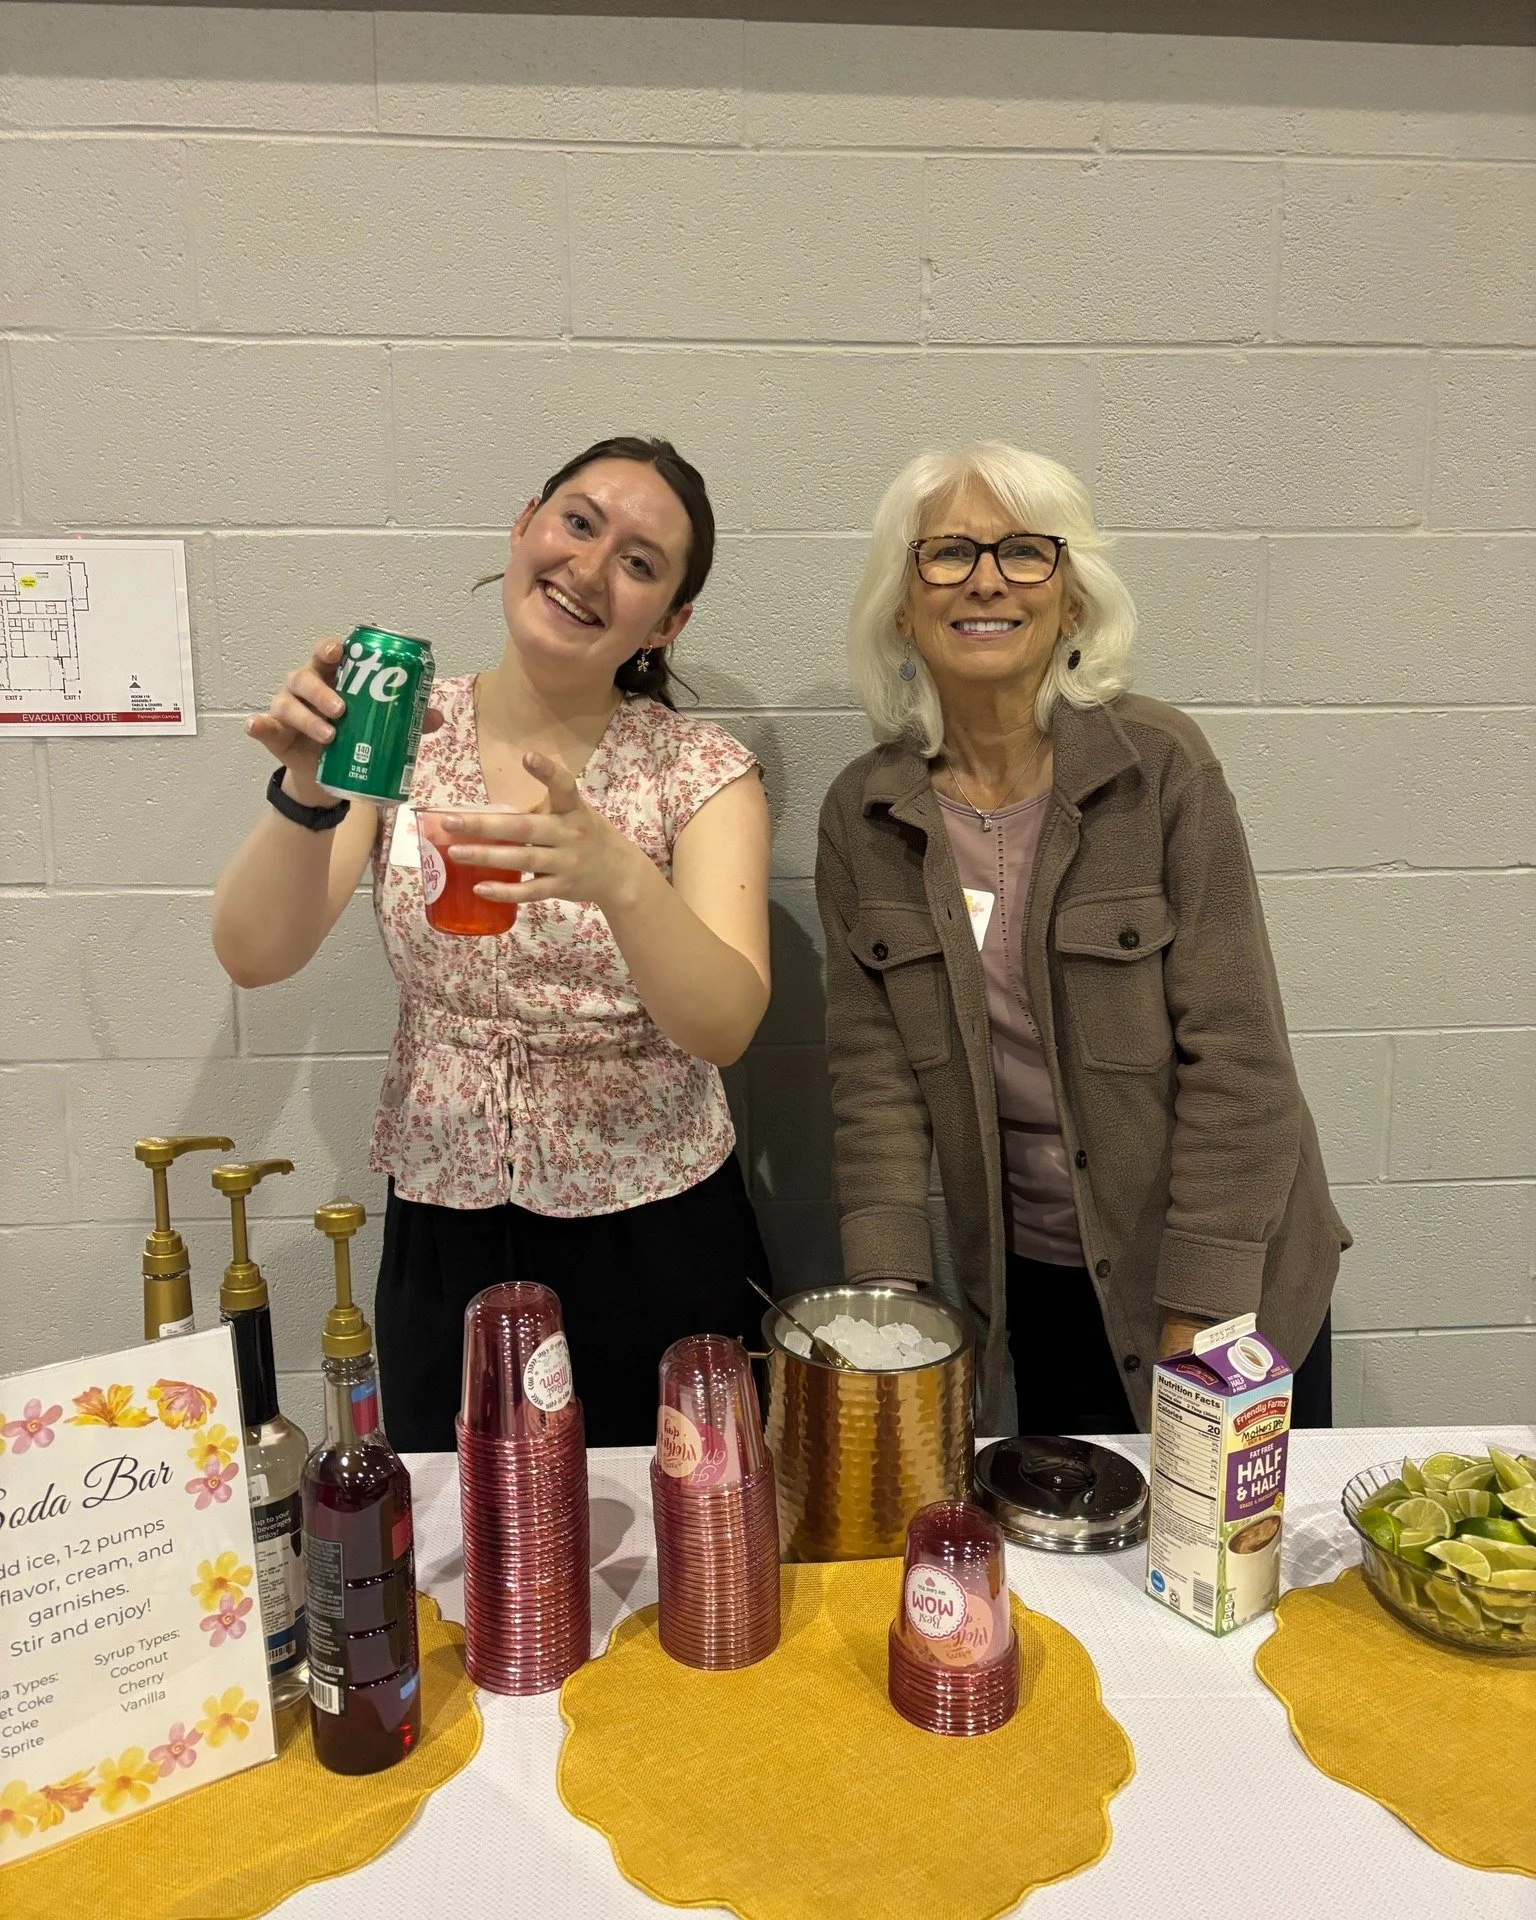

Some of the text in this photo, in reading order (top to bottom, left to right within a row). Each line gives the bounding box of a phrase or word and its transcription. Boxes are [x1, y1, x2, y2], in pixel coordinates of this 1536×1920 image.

[22, 713, 118, 722] EVACUATION ROUTE
[357, 744, 370, 754] 140
[1158, 1374, 1193, 1398] Nutrition
[1194, 1392, 1220, 1409] Facts
[1230, 1377, 1244, 1388] HALF
[1158, 1402, 1183, 1421] Calories
[1207, 1424, 1221, 1436] 20
[1236, 1404, 1267, 1426] Friendly
[1268, 1400, 1287, 1409] Farms
[1250, 1443, 1274, 1459] FAT FREE
[1238, 1447, 1282, 1484] HALF
[82, 1454, 173, 1508] Bar
[1236, 1469, 1281, 1502] & HALF
[256, 1517, 292, 1533] beverages
[27, 1553, 60, 1571] ice,
[64, 1539, 92, 1558] 1-2
[97, 1519, 165, 1552] pumps
[0, 1539, 174, 1606] flavor, cream, and
[28, 1583, 130, 1627] garnishes.
[912, 1590, 954, 1616] MOM
[10, 1598, 152, 1657] Stir and enjoy!
[920, 1612, 942, 1629] Best
[94, 1629, 180, 1666] Syrup Types:
[110, 1651, 169, 1678] Coconut
[13, 1673, 59, 1696] Types:
[118, 1672, 165, 1695] Cherry
[17, 1693, 54, 1713] Coke
[121, 1690, 166, 1713] Vanilla
[2, 1718, 39, 1738] Coke
[0, 1736, 45, 1759] Sprite
